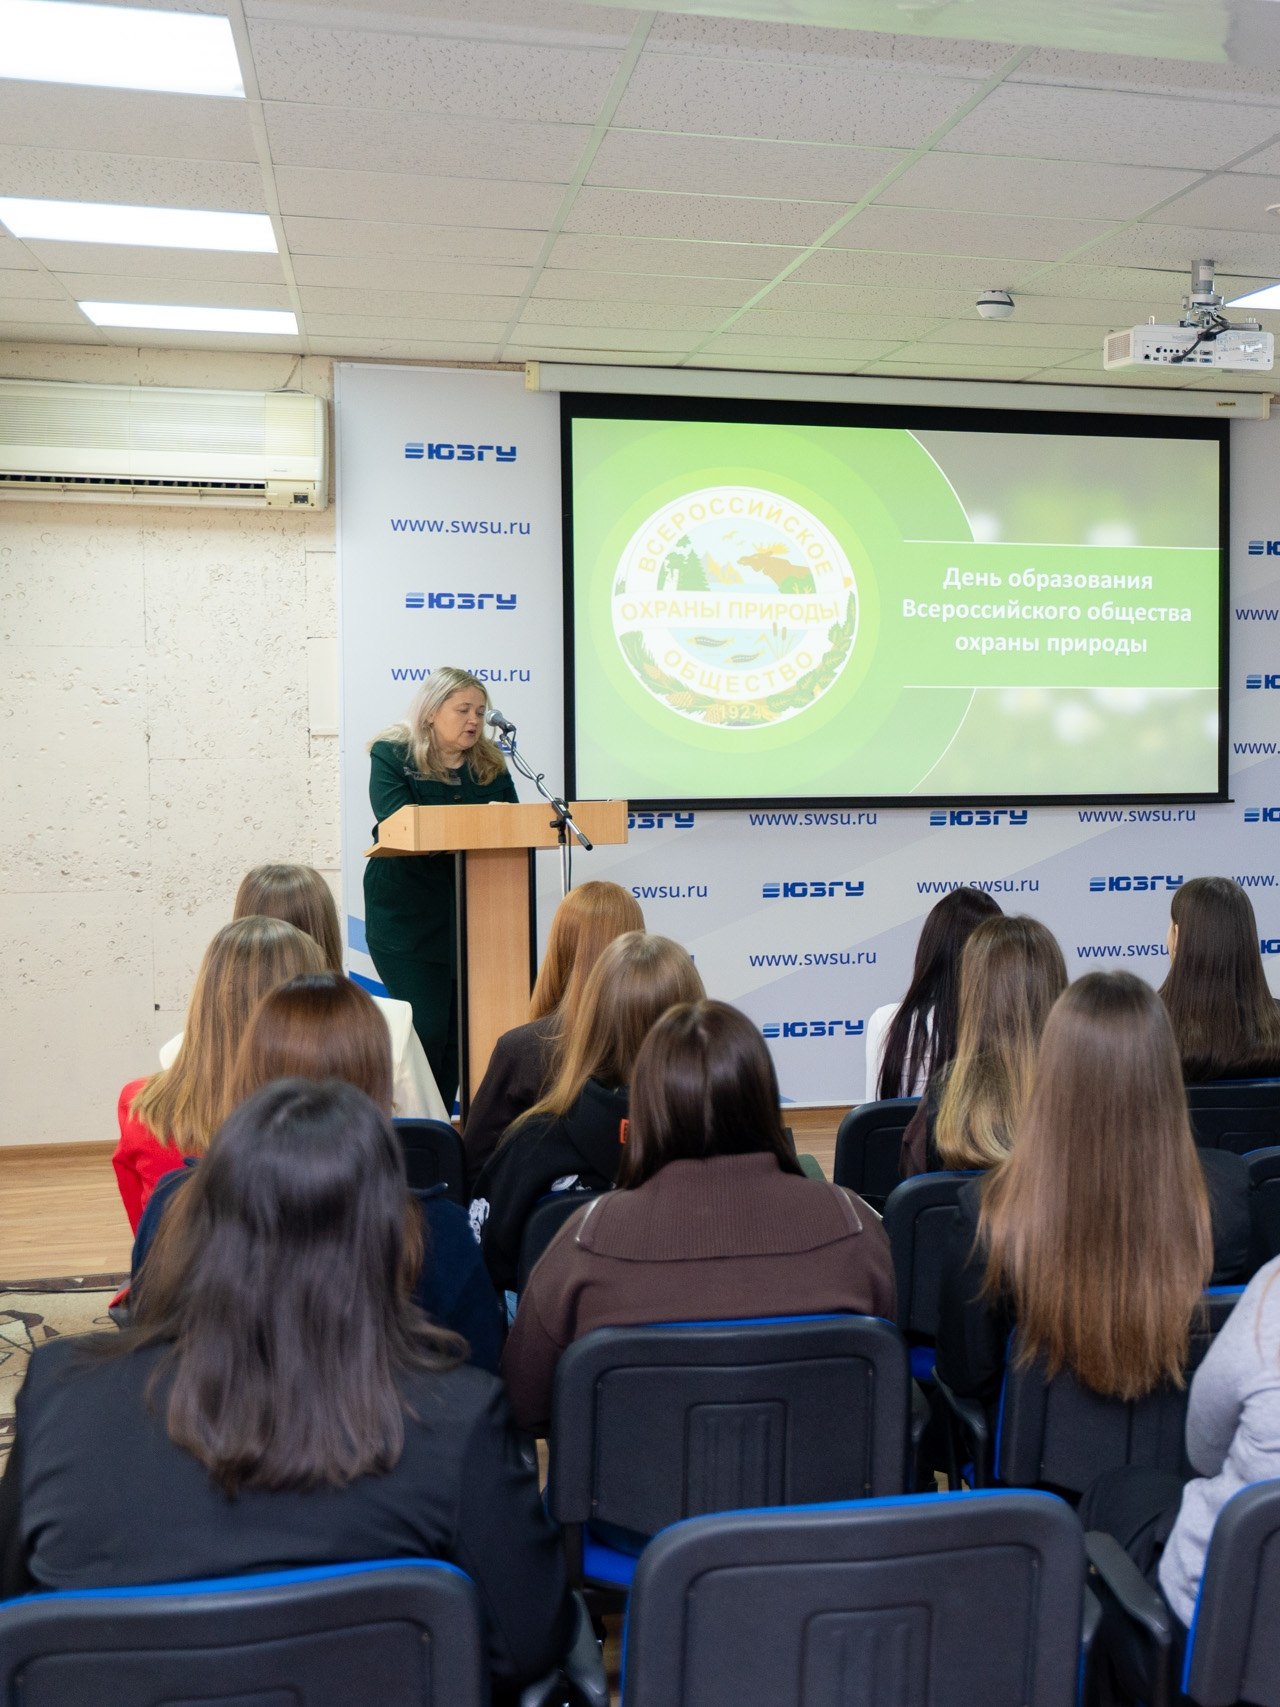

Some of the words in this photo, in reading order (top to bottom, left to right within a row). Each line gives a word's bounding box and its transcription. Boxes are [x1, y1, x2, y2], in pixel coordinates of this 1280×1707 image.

[427, 443, 517, 462] ЮЗГУ
[390, 518, 531, 535] www.swsu.ru
[639, 496, 834, 576] ВСЕРОССИЙСКОЕ
[943, 567, 1001, 590] День
[1008, 568, 1153, 592] образования
[428, 592, 517, 610] ЮЗГУ
[621, 600, 720, 621] ОХРАНЫ
[729, 600, 839, 624] ПРИРОДЫ
[902, 598, 1081, 623] Всероссийского
[1087, 600, 1192, 624] общества
[955, 634, 1039, 655] охраны
[1047, 634, 1147, 656] природы
[663, 650, 813, 694] ОБЩЕСТВО
[627, 812, 694, 829] ЗГУ
[749, 810, 877, 826] www.swsu.ru
[949, 810, 1028, 826] ЮЗГУ
[1078, 807, 1196, 823] www.swsu.ru
[631, 884, 708, 899] swsu.ru
[783, 881, 864, 897] ЮЗГУ
[1108, 875, 1184, 891] ЮЗГУ
[1076, 941, 1169, 958] www.swsu
[749, 950, 877, 967] www.swsu.ru
[783, 1019, 864, 1038] ЮЗГУ
